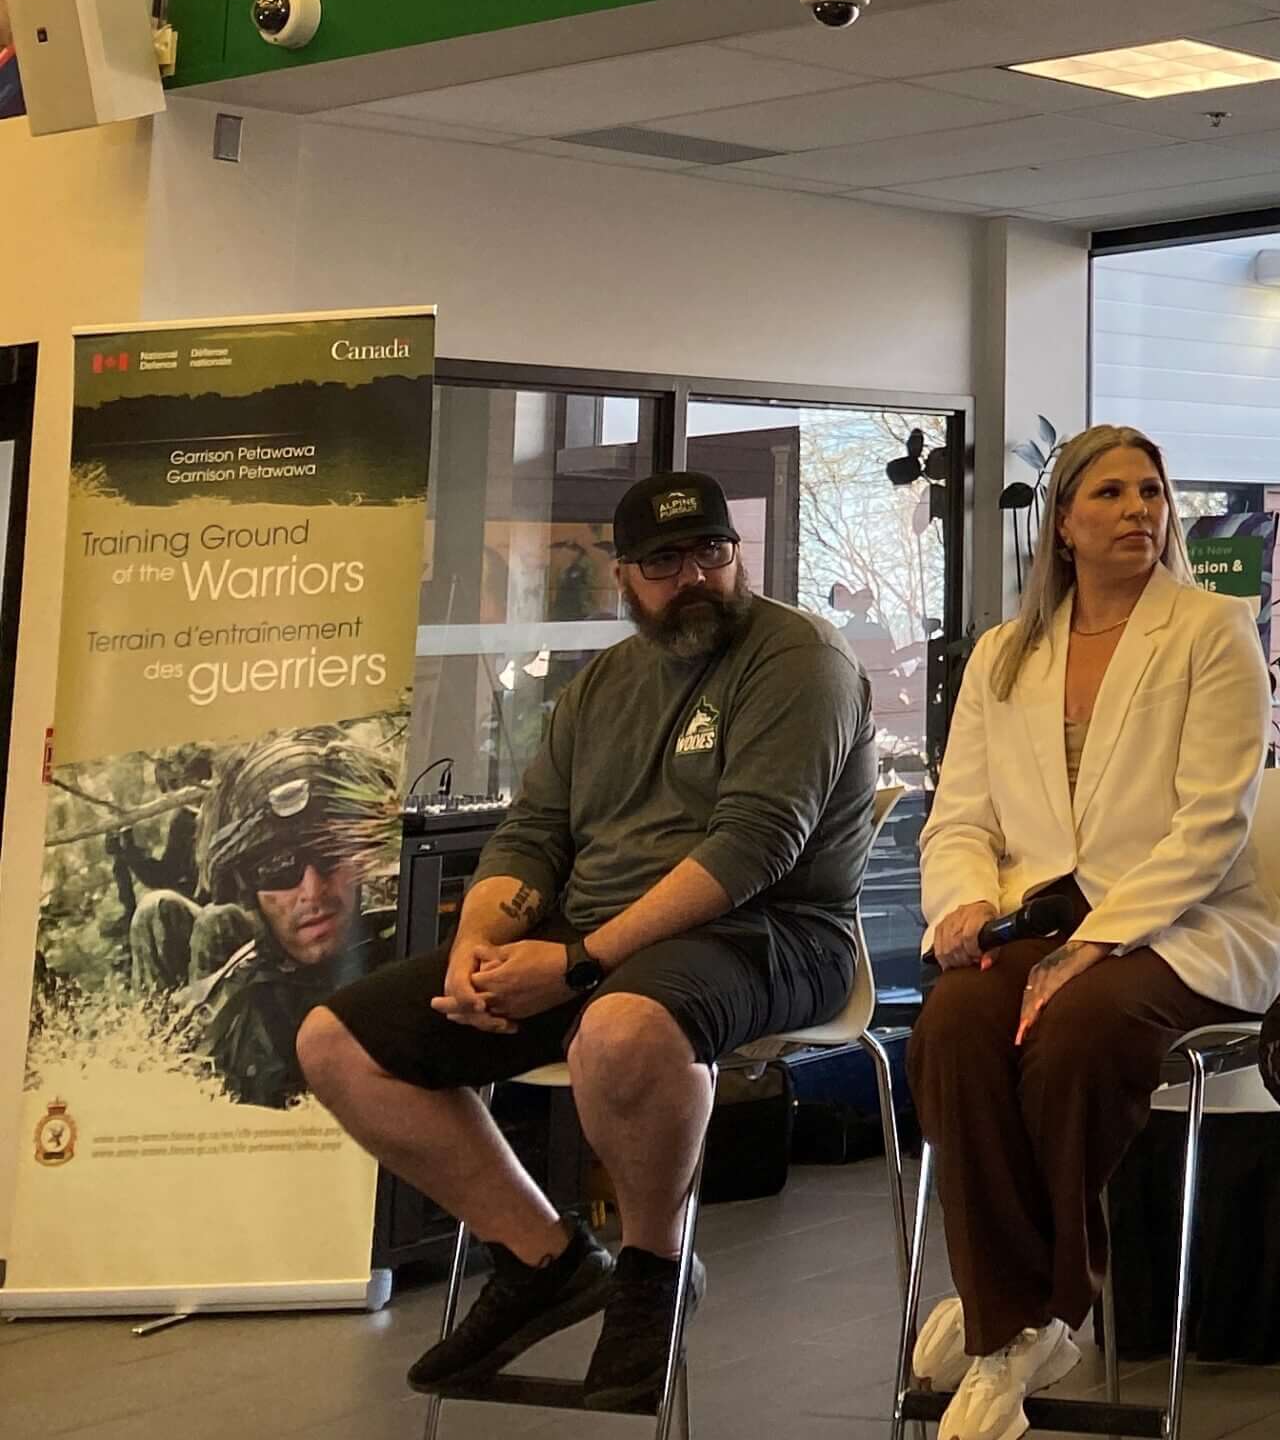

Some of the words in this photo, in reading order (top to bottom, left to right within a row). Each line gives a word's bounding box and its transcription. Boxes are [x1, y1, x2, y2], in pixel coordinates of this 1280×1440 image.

[330, 337, 411, 361] Canada
[170, 446, 234, 465] Garrison
[238, 443, 316, 462] Petawawa
[166, 466, 235, 484] Garnison
[238, 463, 316, 481] Petawawa
[81, 528, 190, 558] Training
[200, 519, 310, 550] Ground
[112, 563, 135, 585] of
[139, 562, 175, 583] the
[182, 555, 365, 601] Warriors
[87, 627, 166, 653] Terrain
[143, 660, 184, 681] des
[187, 646, 387, 706] guerriers
